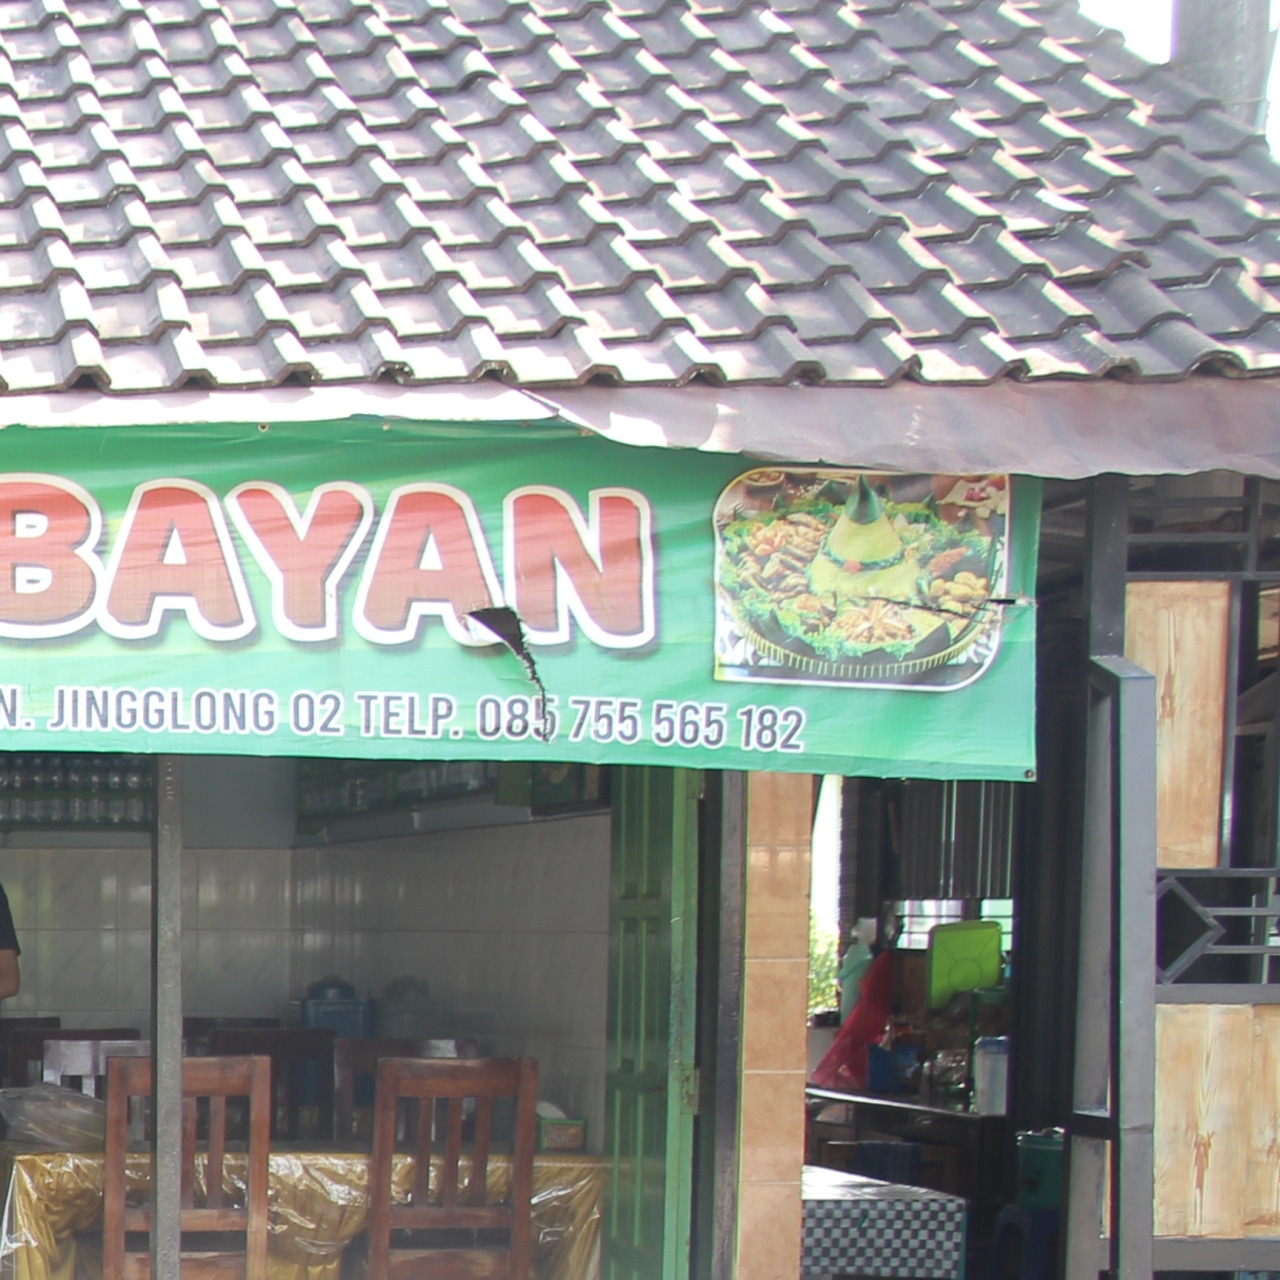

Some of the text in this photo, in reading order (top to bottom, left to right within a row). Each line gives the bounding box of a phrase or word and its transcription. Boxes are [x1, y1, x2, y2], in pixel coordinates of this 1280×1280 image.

[46, 685, 279, 735] JINGGLONG
[290, 689, 345, 736] 02
[355, 690, 463, 740] TELP.
[476, 694, 557, 742] 085
[569, 697, 643, 745] 755
[652, 699, 726, 750] 565
[737, 704, 805, 754] 182
